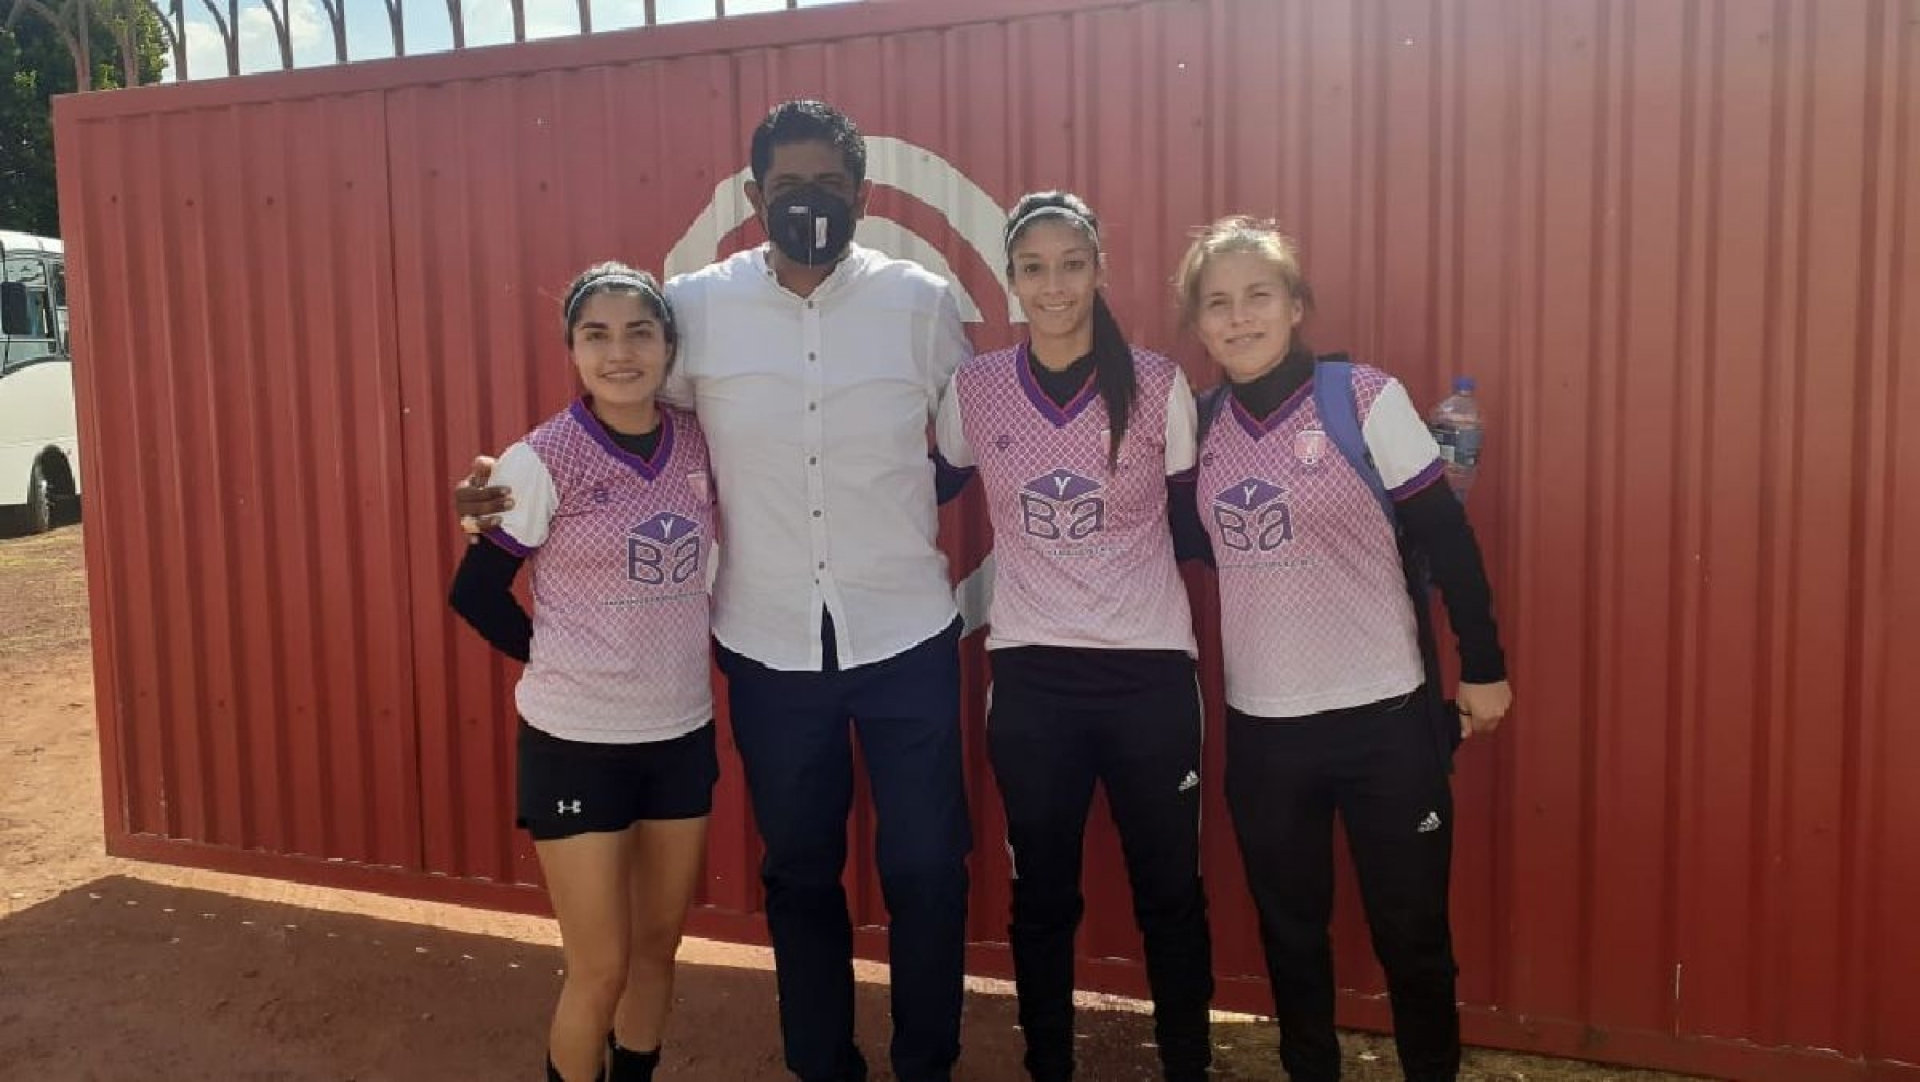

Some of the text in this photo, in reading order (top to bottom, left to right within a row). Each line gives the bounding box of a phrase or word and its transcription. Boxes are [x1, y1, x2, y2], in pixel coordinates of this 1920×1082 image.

[1053, 476, 1071, 496] Y
[1243, 484, 1257, 505] Y
[660, 517, 674, 539] Y
